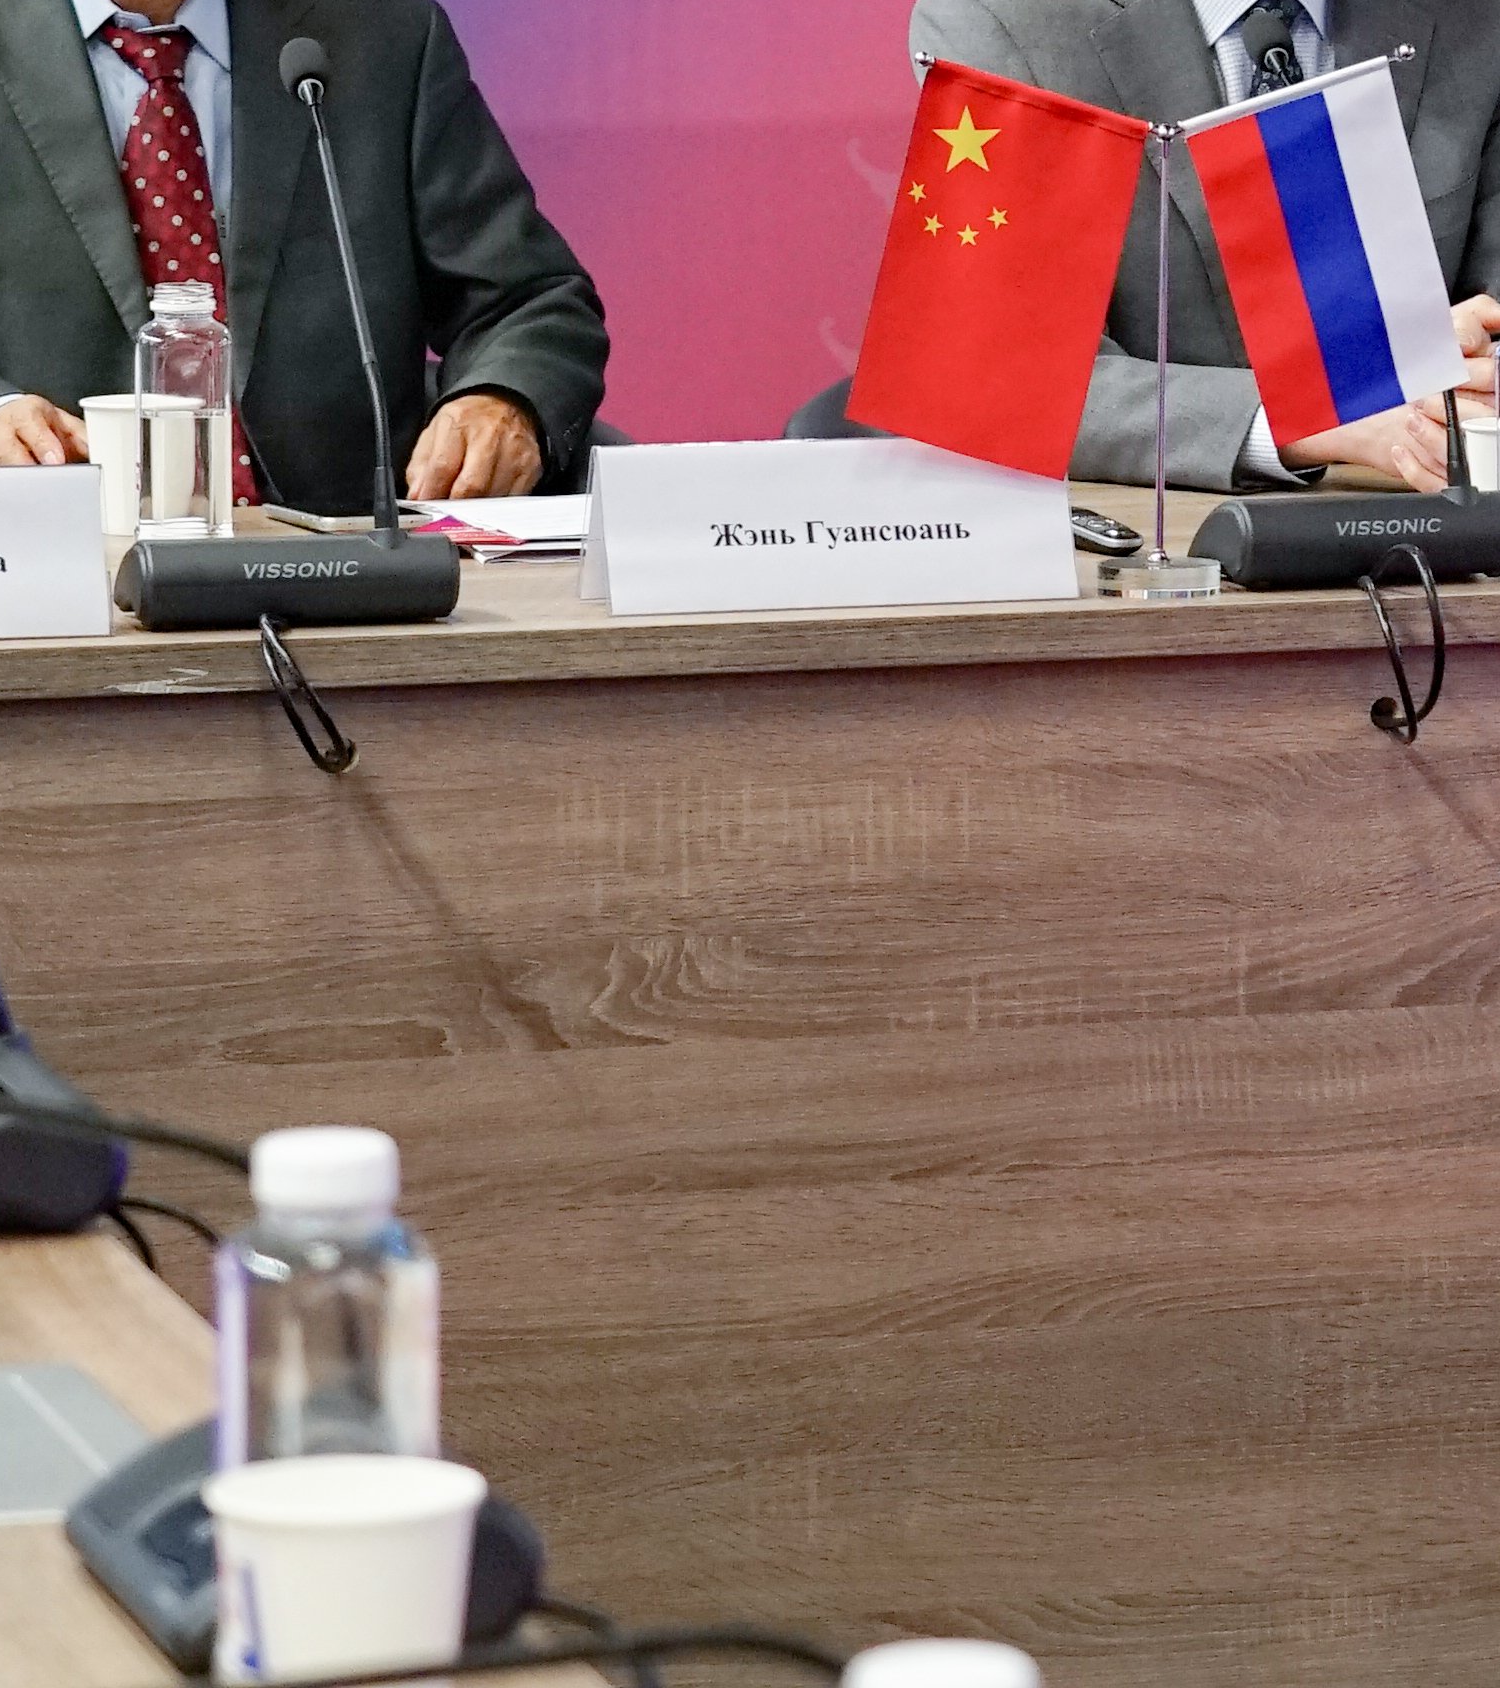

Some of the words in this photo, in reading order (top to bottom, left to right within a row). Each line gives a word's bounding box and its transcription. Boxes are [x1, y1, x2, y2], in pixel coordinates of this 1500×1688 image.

[710, 523, 796, 547] Жэнь
[804, 520, 971, 550] Гуансюань
[1335, 518, 1442, 536] VISSONIC
[243, 560, 360, 579] VISSONIC
